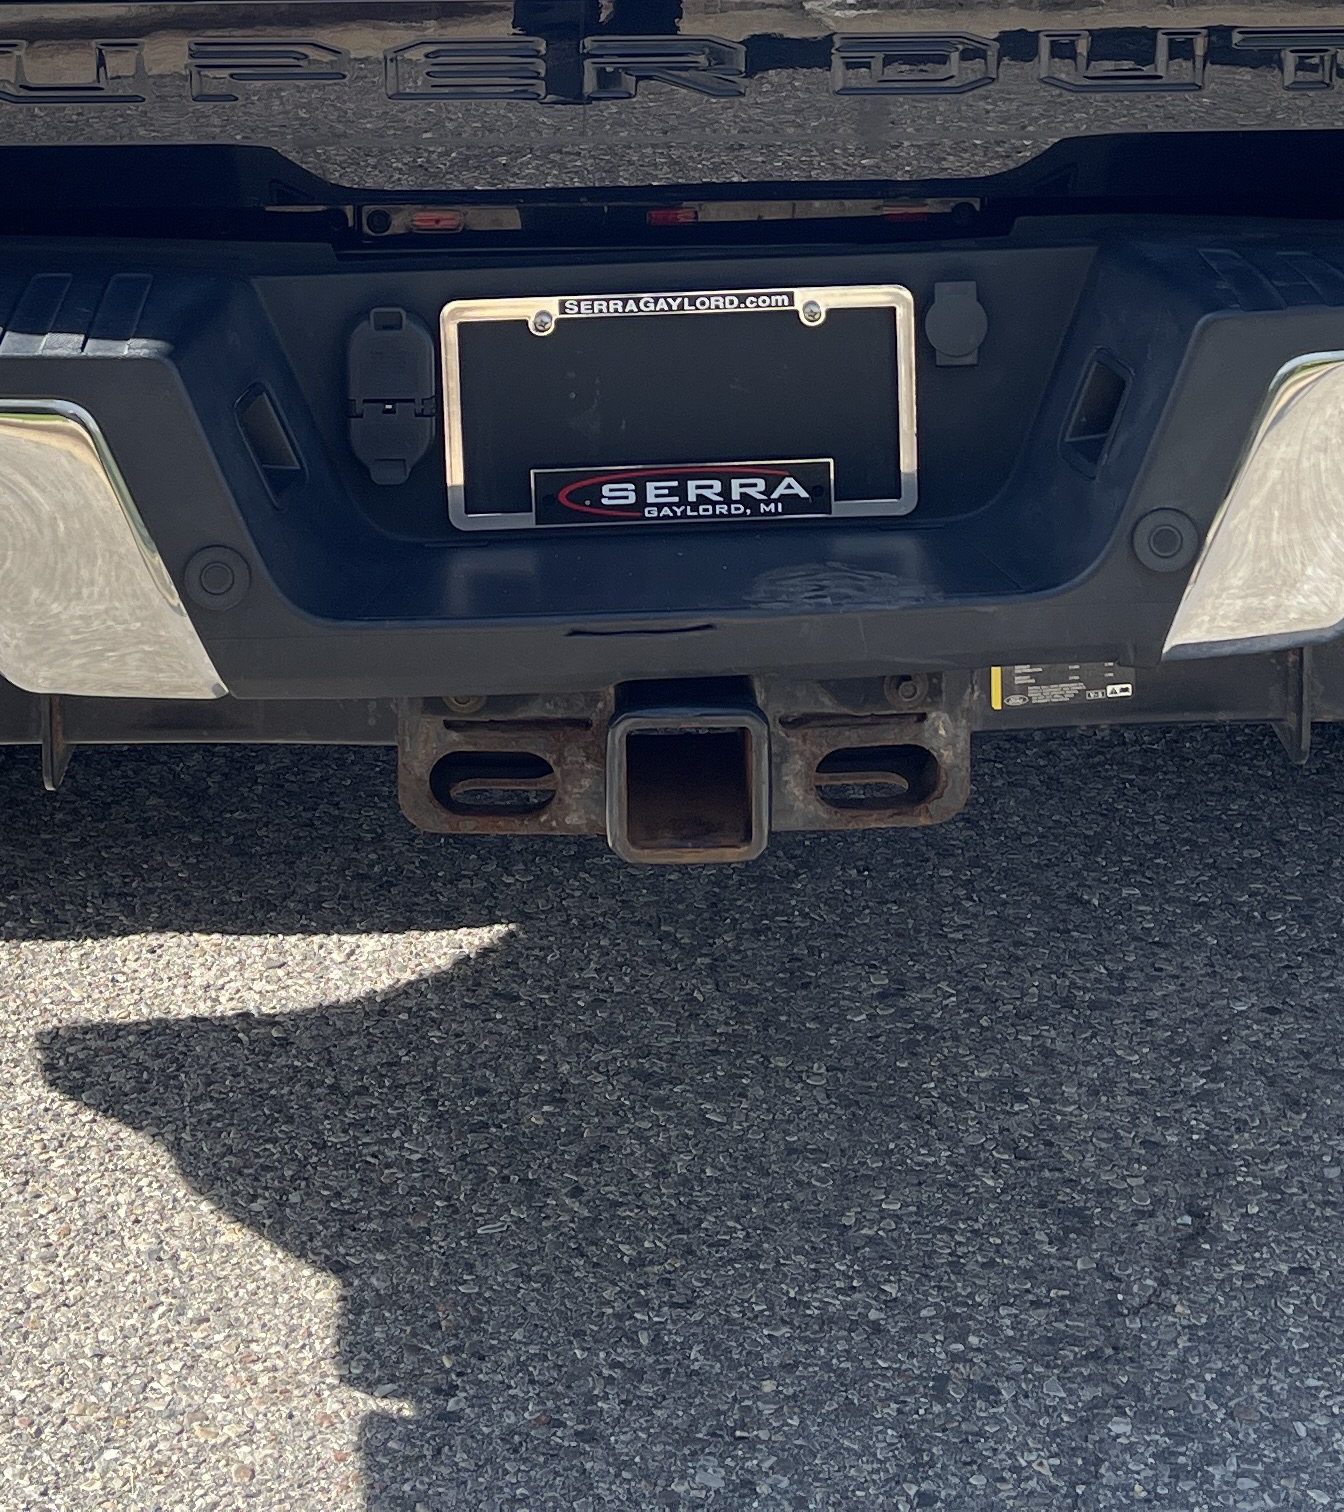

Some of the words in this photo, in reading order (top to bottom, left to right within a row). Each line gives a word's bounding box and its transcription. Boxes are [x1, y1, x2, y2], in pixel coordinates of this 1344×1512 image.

[563, 293, 790, 315] SERRAGAYLORD.com
[600, 476, 811, 506] SERRA
[643, 503, 752, 518] GAYLORD,
[759, 502, 783, 514] MI
